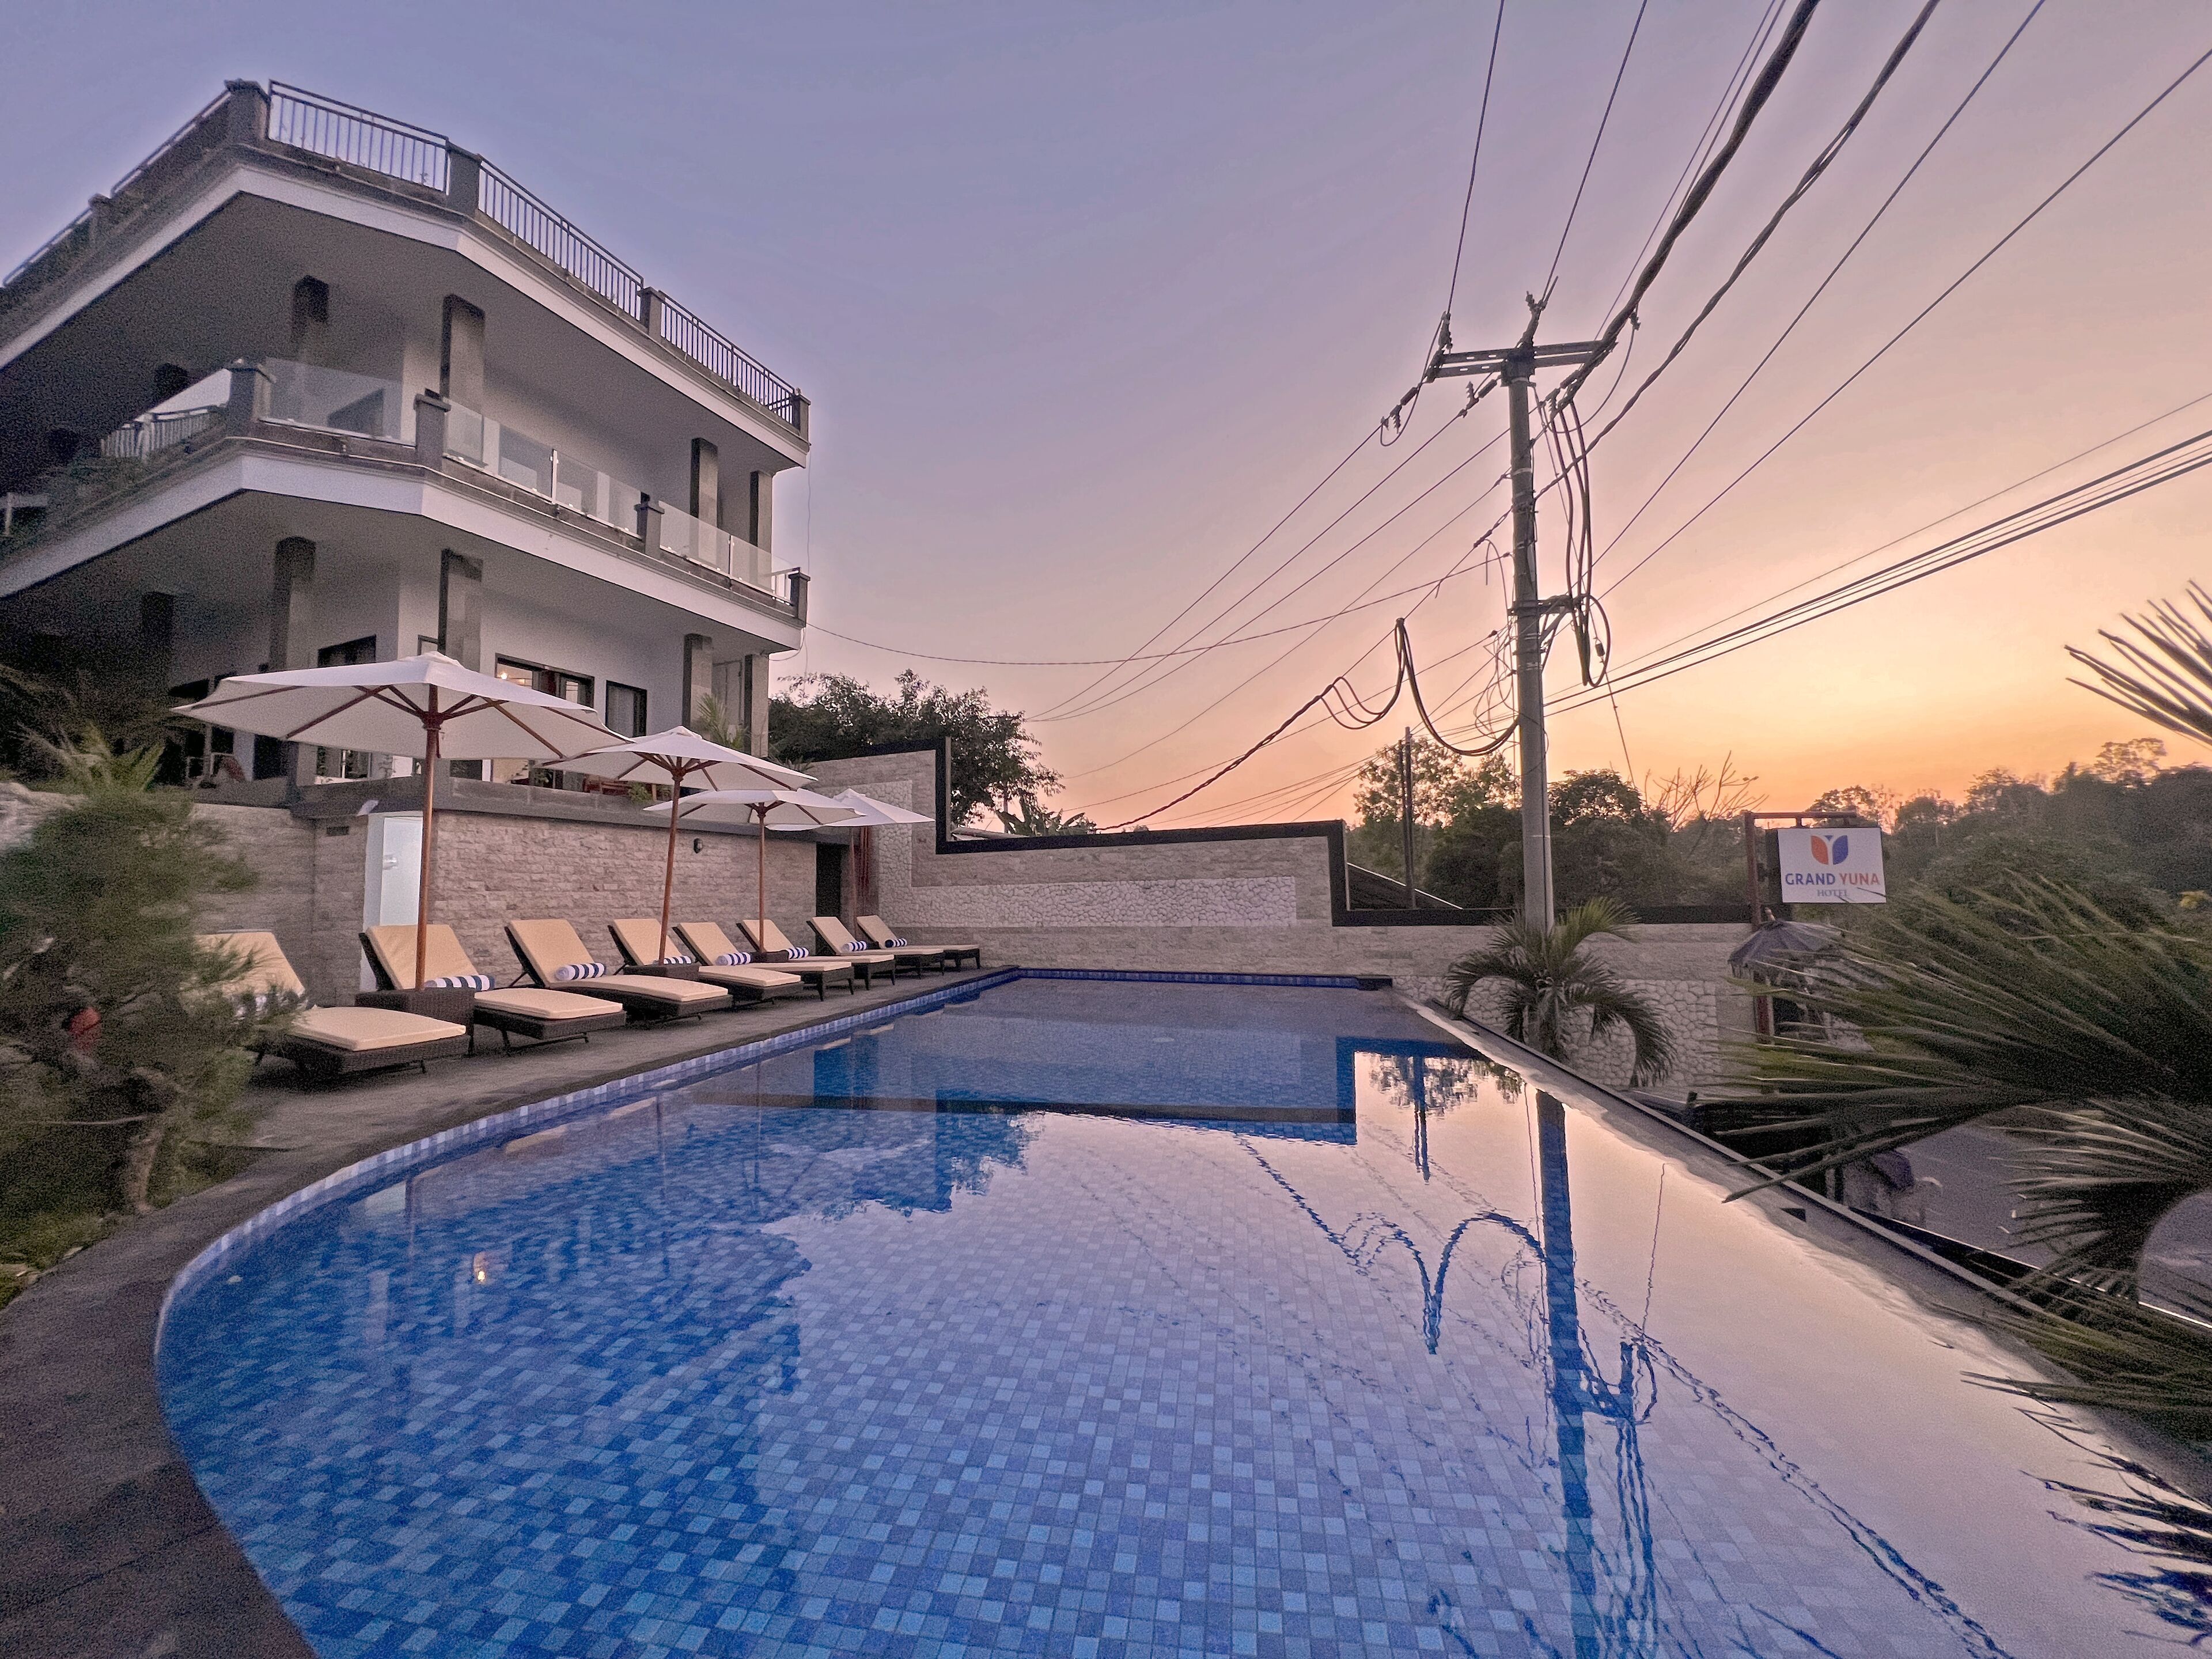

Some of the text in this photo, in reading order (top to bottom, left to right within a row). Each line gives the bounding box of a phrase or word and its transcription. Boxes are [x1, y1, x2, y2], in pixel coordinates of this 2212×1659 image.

[1785, 873, 1880, 885] GRAND YUNA
[1817, 889, 1848, 897] HOTEL
